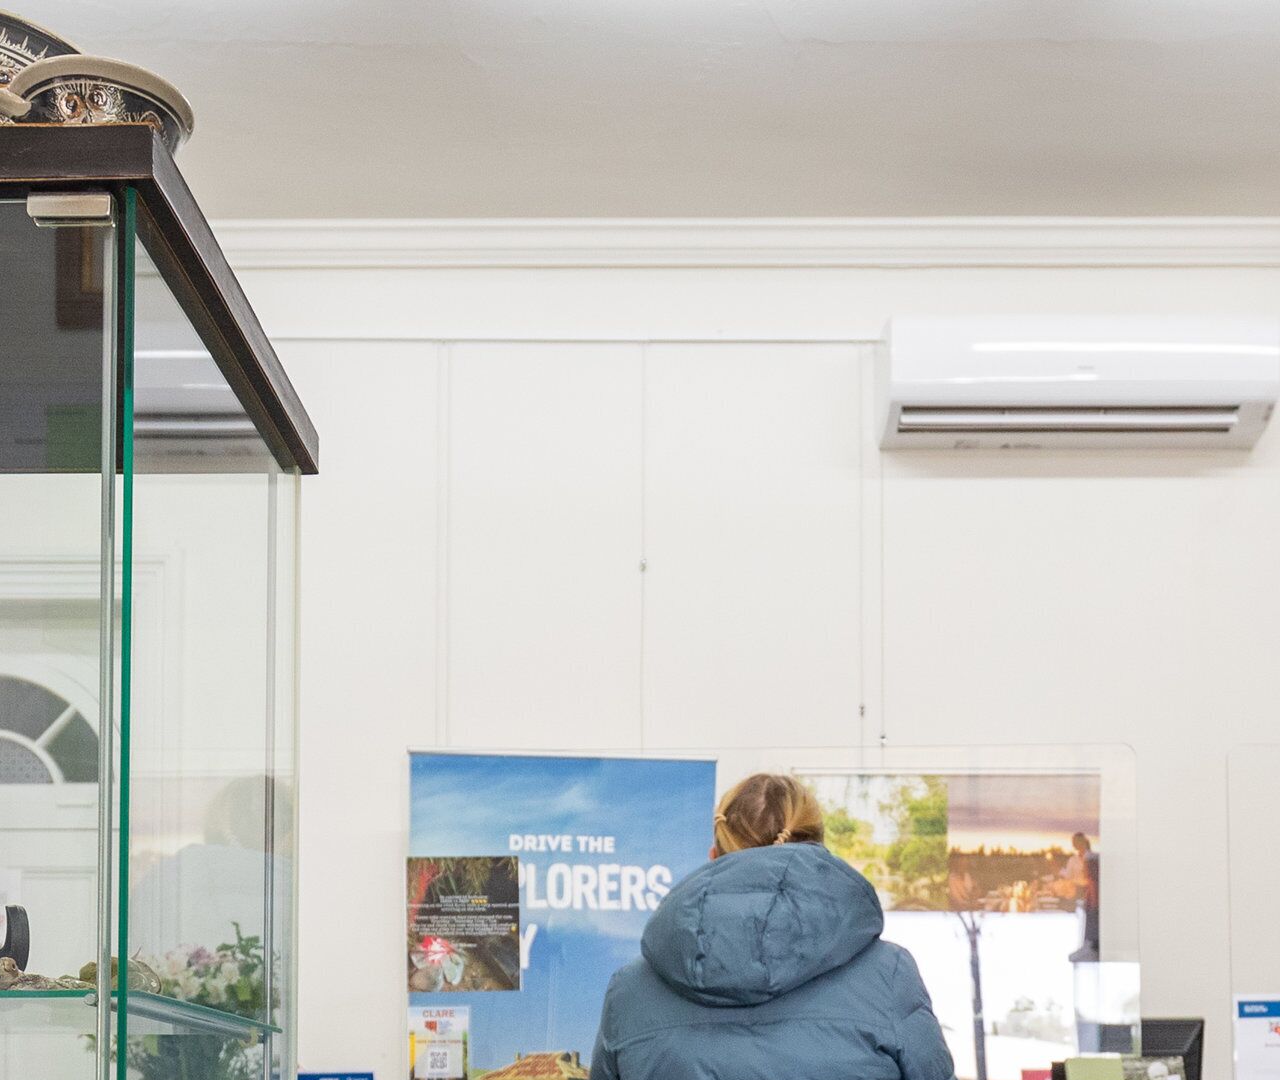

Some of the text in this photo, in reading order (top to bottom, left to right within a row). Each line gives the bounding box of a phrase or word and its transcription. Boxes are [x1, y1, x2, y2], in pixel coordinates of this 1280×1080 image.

[509, 833, 616, 853] DRIVE THE
[422, 1009, 455, 1018] CLARE
